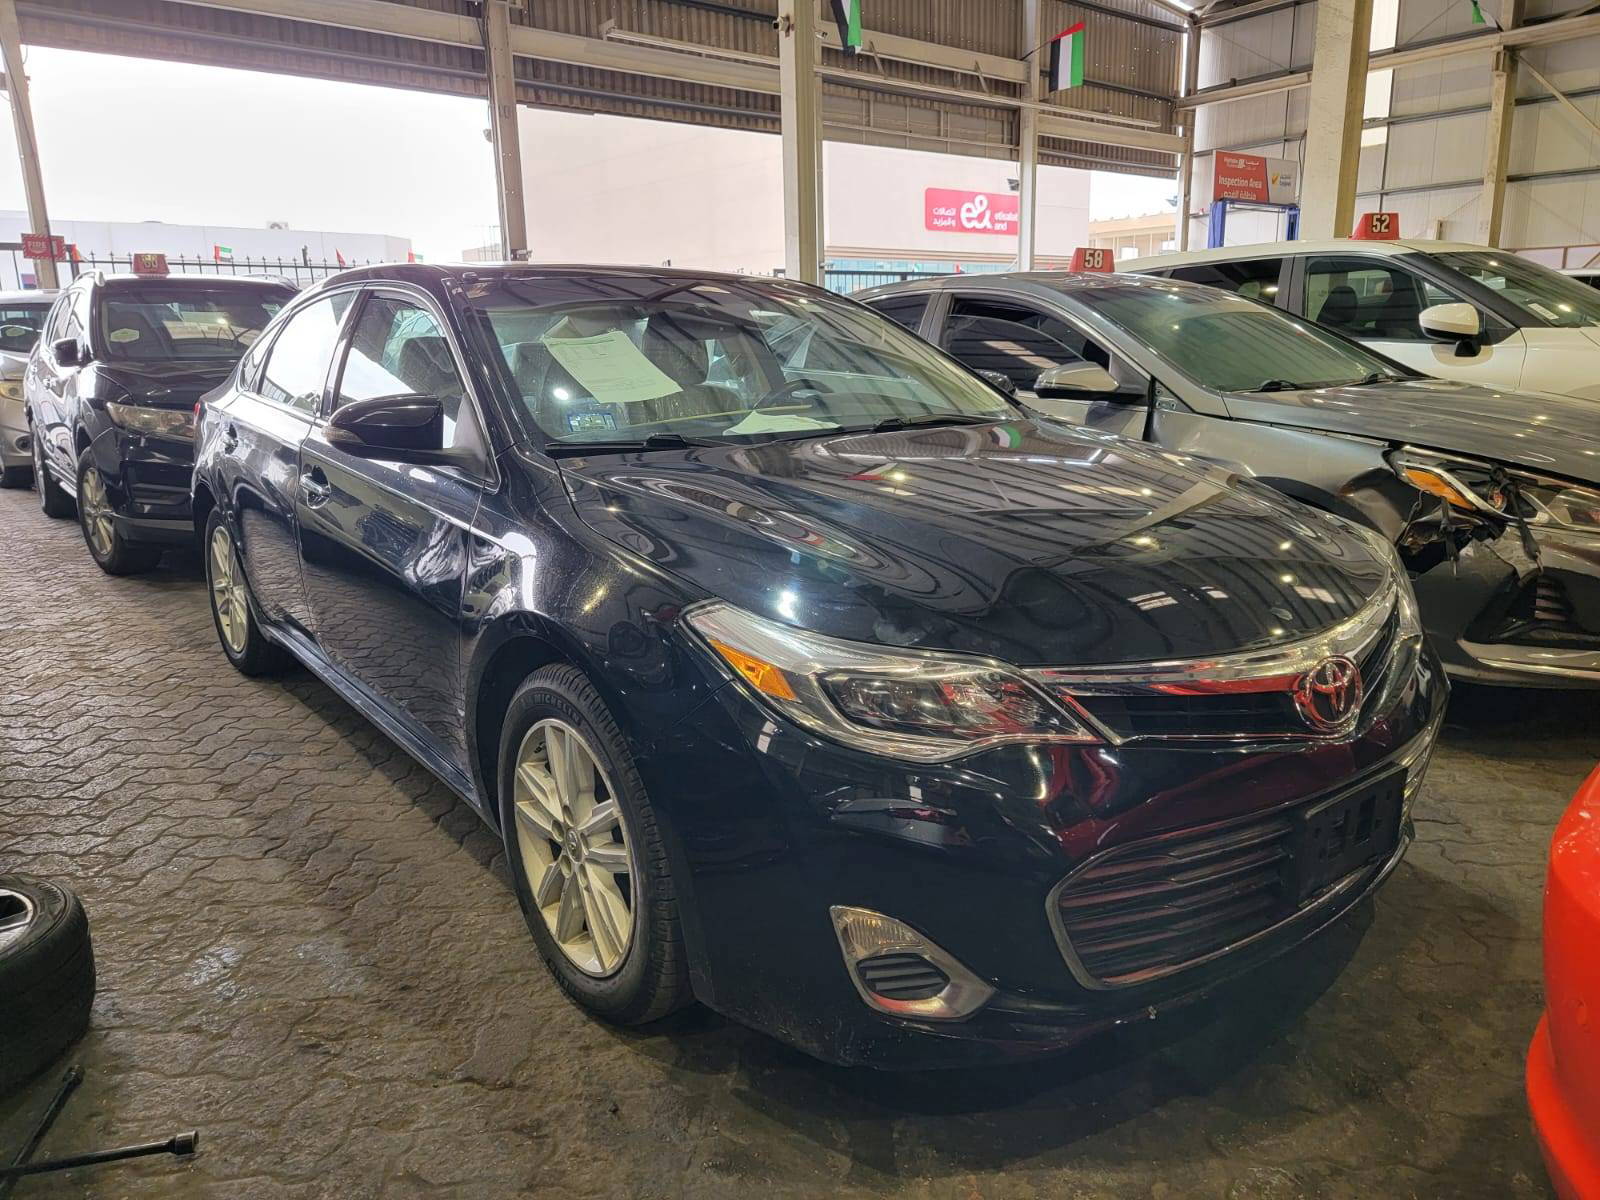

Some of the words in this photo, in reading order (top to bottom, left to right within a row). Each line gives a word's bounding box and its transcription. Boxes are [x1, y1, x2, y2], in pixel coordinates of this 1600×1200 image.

[1218, 175, 1248, 188] Inspection
[1249, 178, 1262, 189] Area
[993, 221, 1008, 231] and
[1372, 214, 1390, 233] 52
[1084, 249, 1104, 269] 58
[533, 692, 580, 723] MICHELIN
